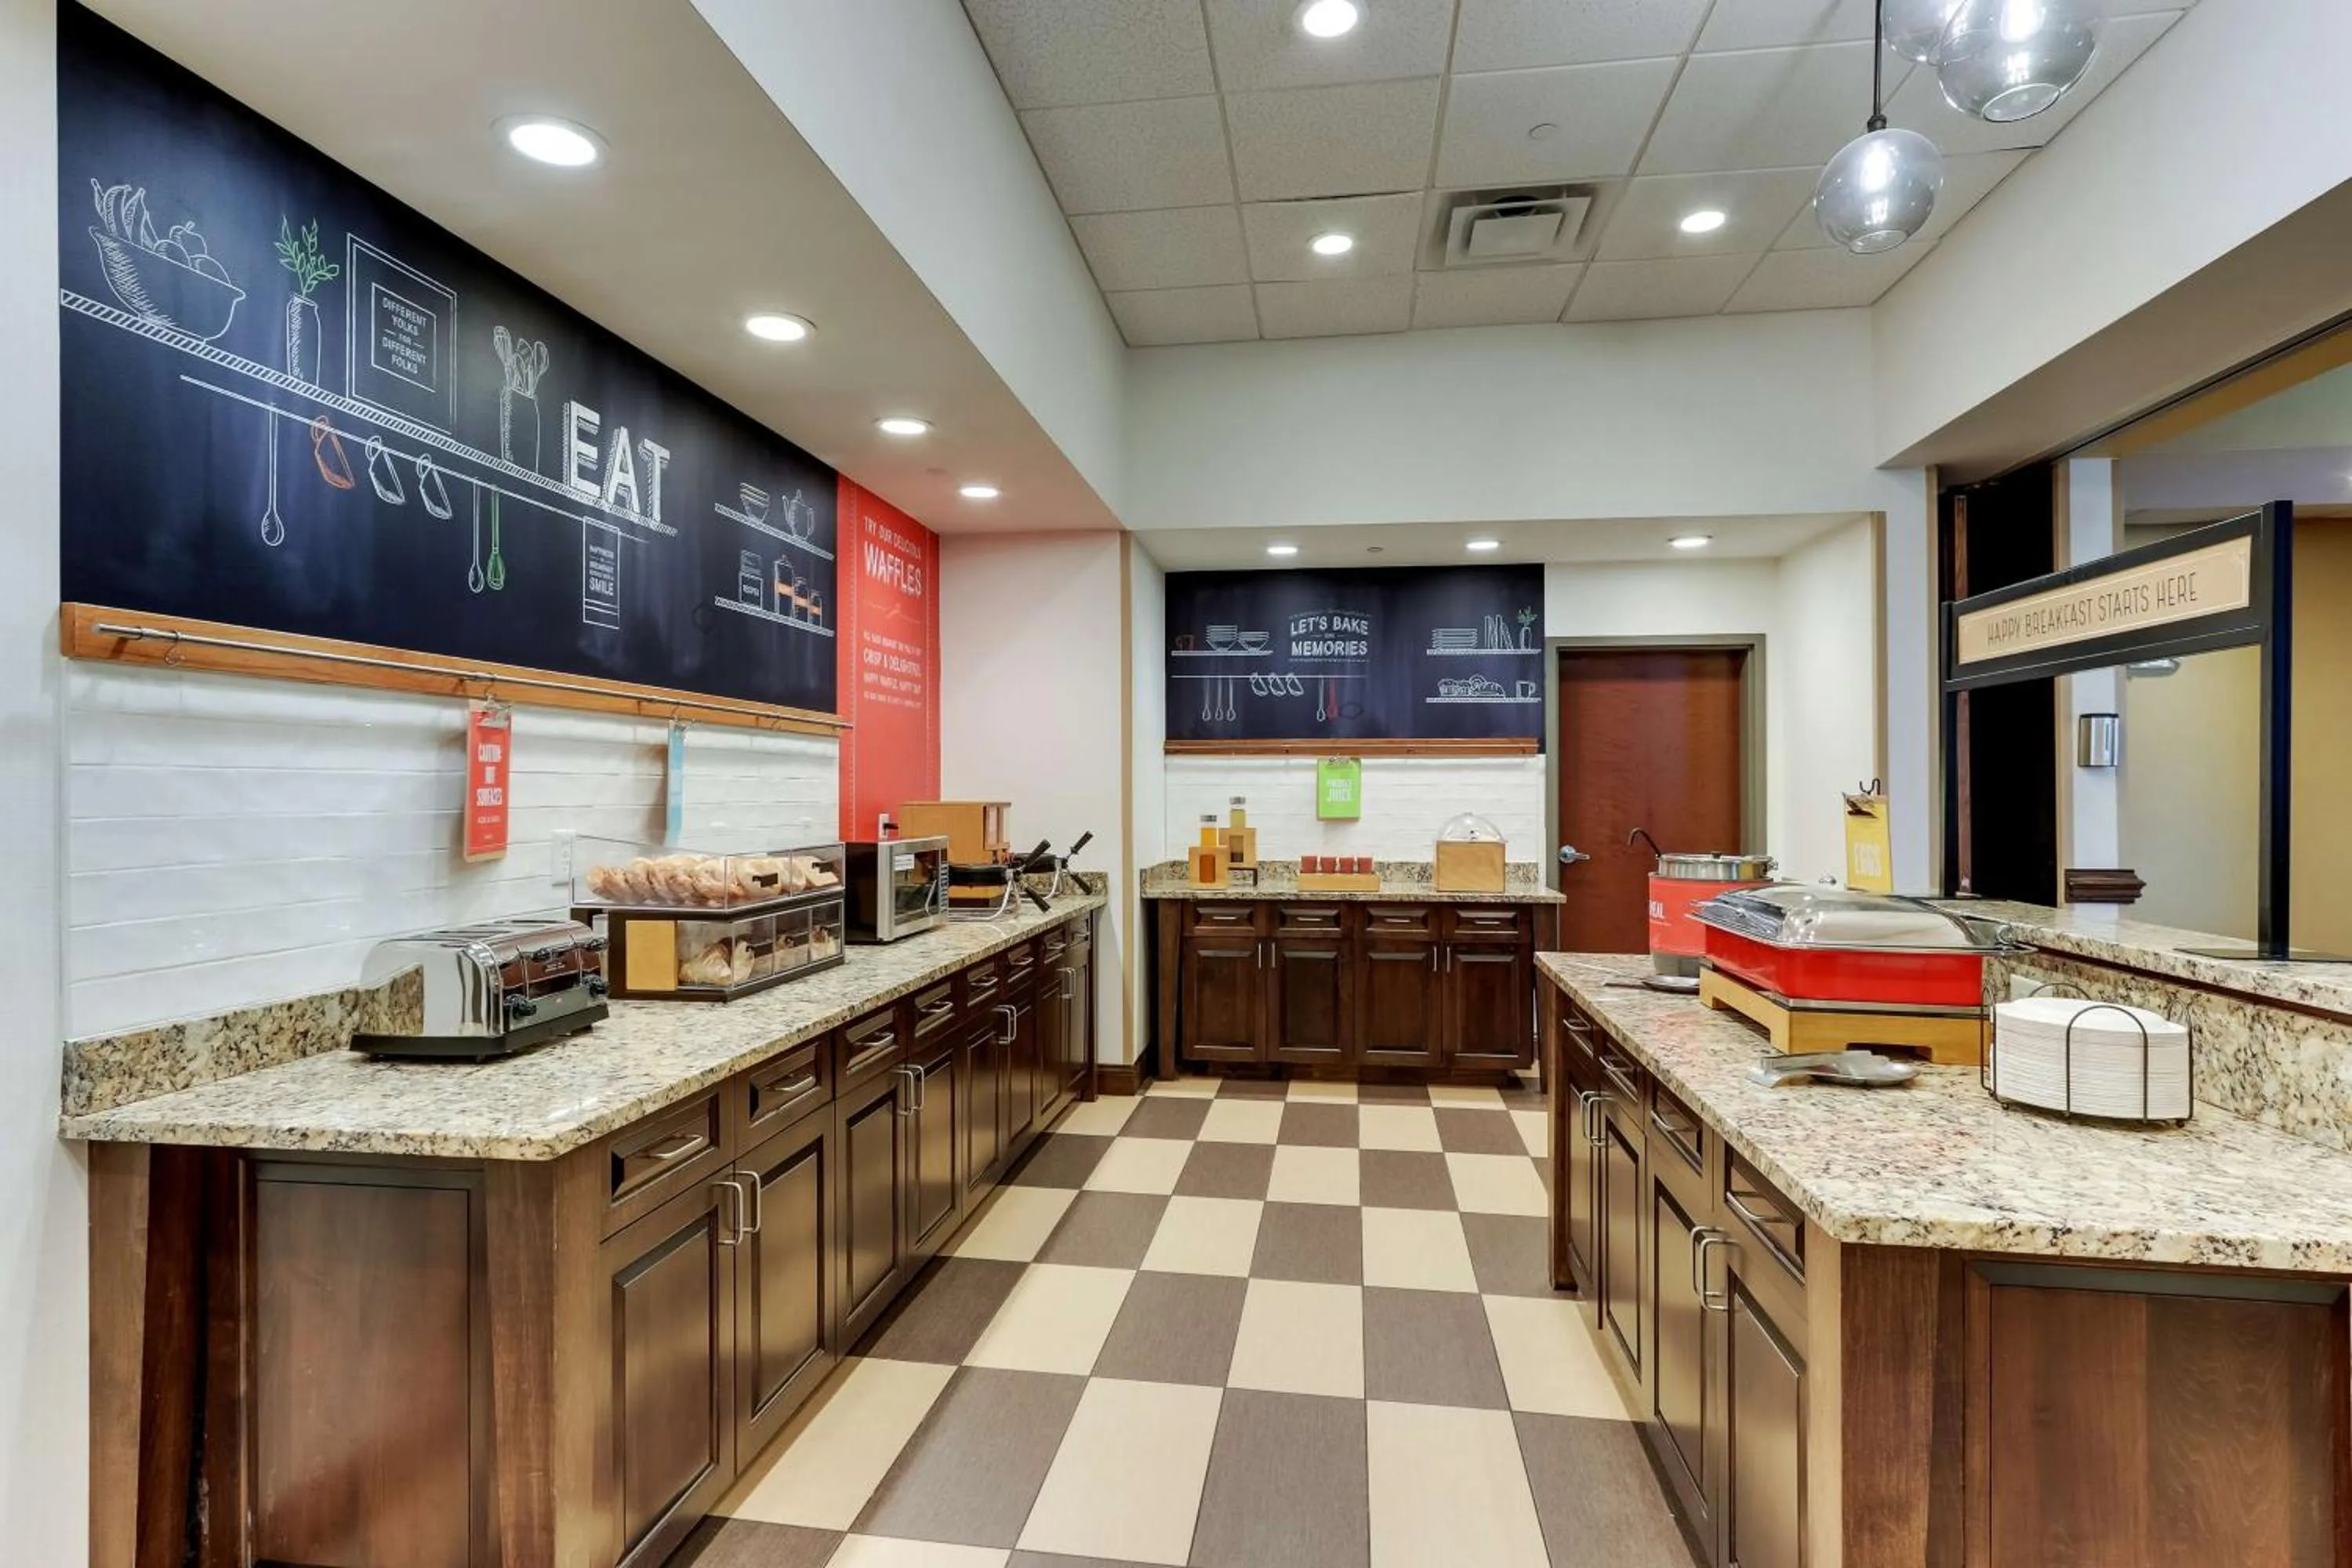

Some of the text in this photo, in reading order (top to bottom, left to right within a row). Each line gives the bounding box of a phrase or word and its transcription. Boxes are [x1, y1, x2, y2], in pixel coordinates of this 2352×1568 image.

[382, 297, 427, 328] DIFFERENT
[391, 315, 419, 336] YOLKS
[382, 337, 427, 365] DIFFERENT
[399, 334, 412, 346] FOR
[391, 354, 419, 375] FOLKS
[563, 400, 671, 524] EAT
[864, 516, 877, 536] TRY
[878, 524, 892, 545] OUR
[864, 540, 922, 598] WAFFLES
[589, 577, 614, 597] SMILE
[1987, 572, 2198, 647] HAPPY BREAKFAST STARTS HERE
[1290, 615, 1369, 637] LET'S BAKE
[1291, 641, 1368, 656] MEMORIES
